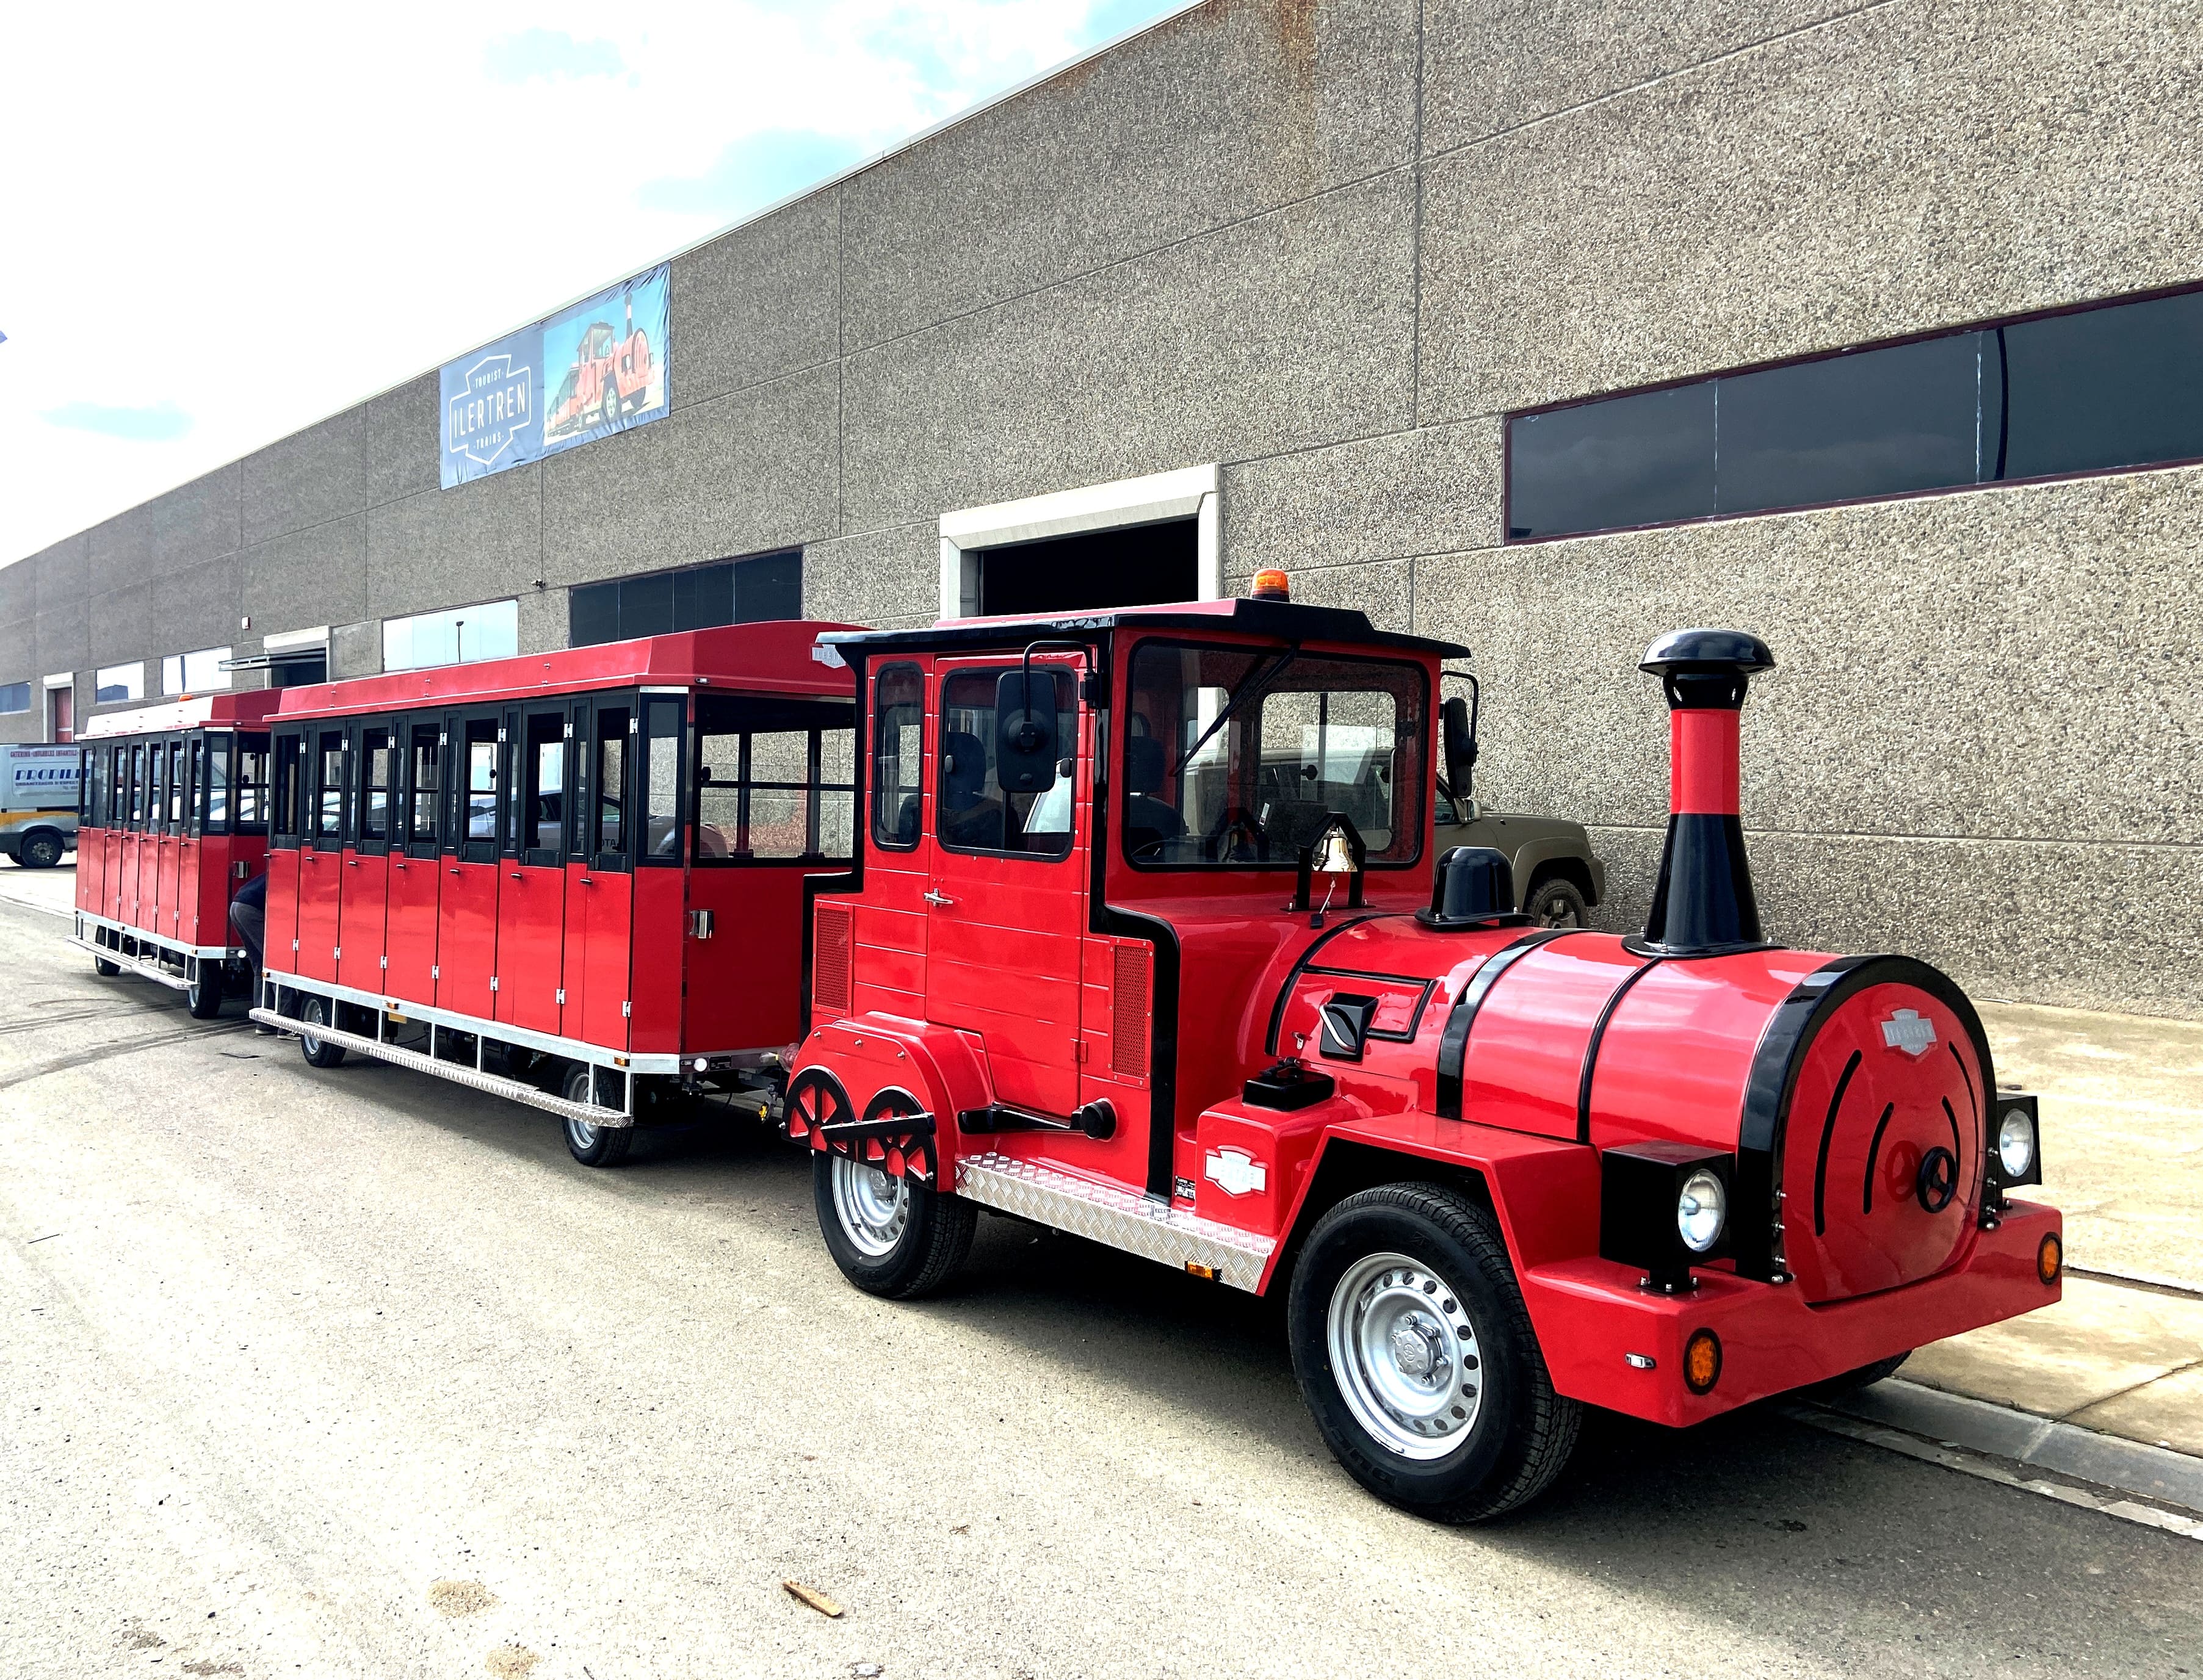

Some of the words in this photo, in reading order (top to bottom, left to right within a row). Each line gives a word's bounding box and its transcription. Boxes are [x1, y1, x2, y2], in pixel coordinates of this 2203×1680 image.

[475, 368, 501, 389] TOURIST
[454, 381, 526, 438] ILERTREN
[476, 431, 501, 450] TRAINS
